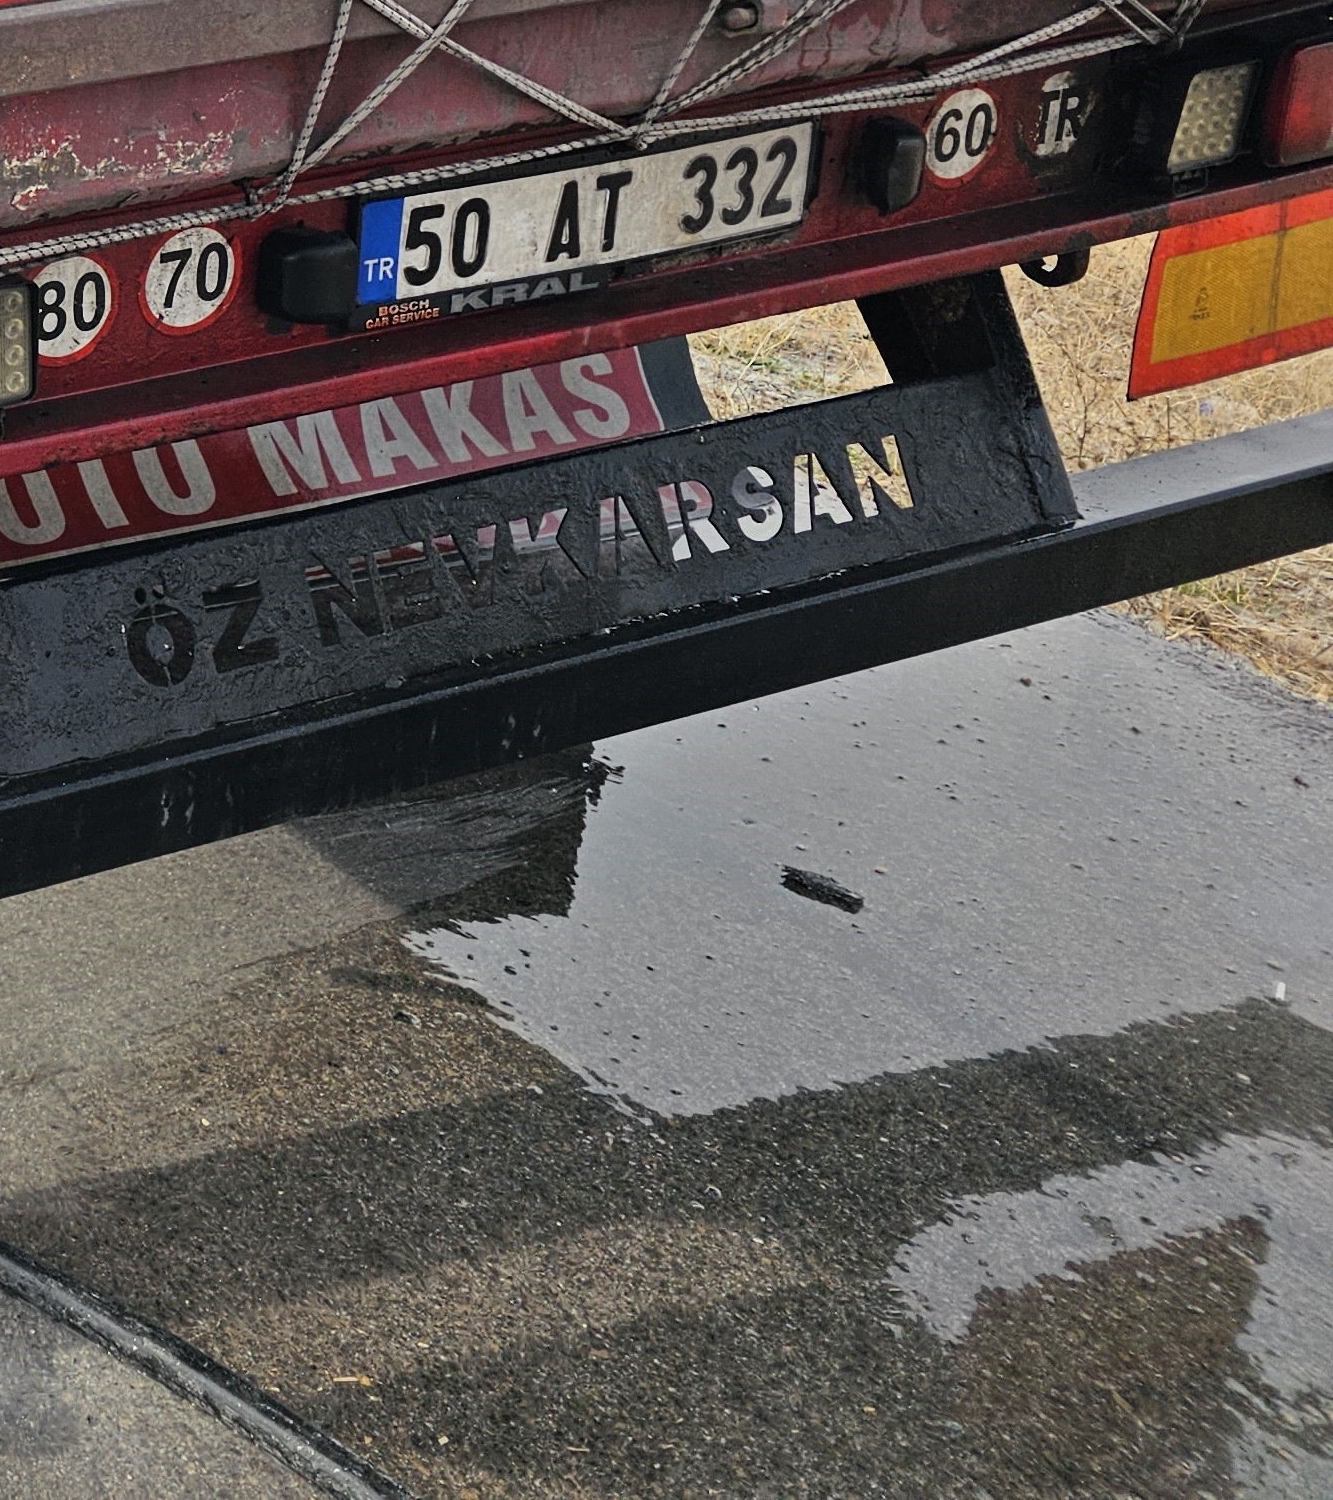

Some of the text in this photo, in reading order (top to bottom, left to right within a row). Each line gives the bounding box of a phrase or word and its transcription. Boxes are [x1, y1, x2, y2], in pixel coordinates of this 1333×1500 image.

[934, 103, 993, 163] 60
[403, 137, 799, 287] 50 AT 332
[159, 242, 229, 309] 70
[364, 257, 395, 283] TR
[450, 272, 600, 314] KRAL
[38, 271, 106, 341] 80
[365, 307, 440, 330] CAR SERVICE
[378, 299, 430, 317] BOSCH
[246, 351, 632, 499] MAKAS
[126, 435, 915, 688] ÖZ NEVKARSAN
